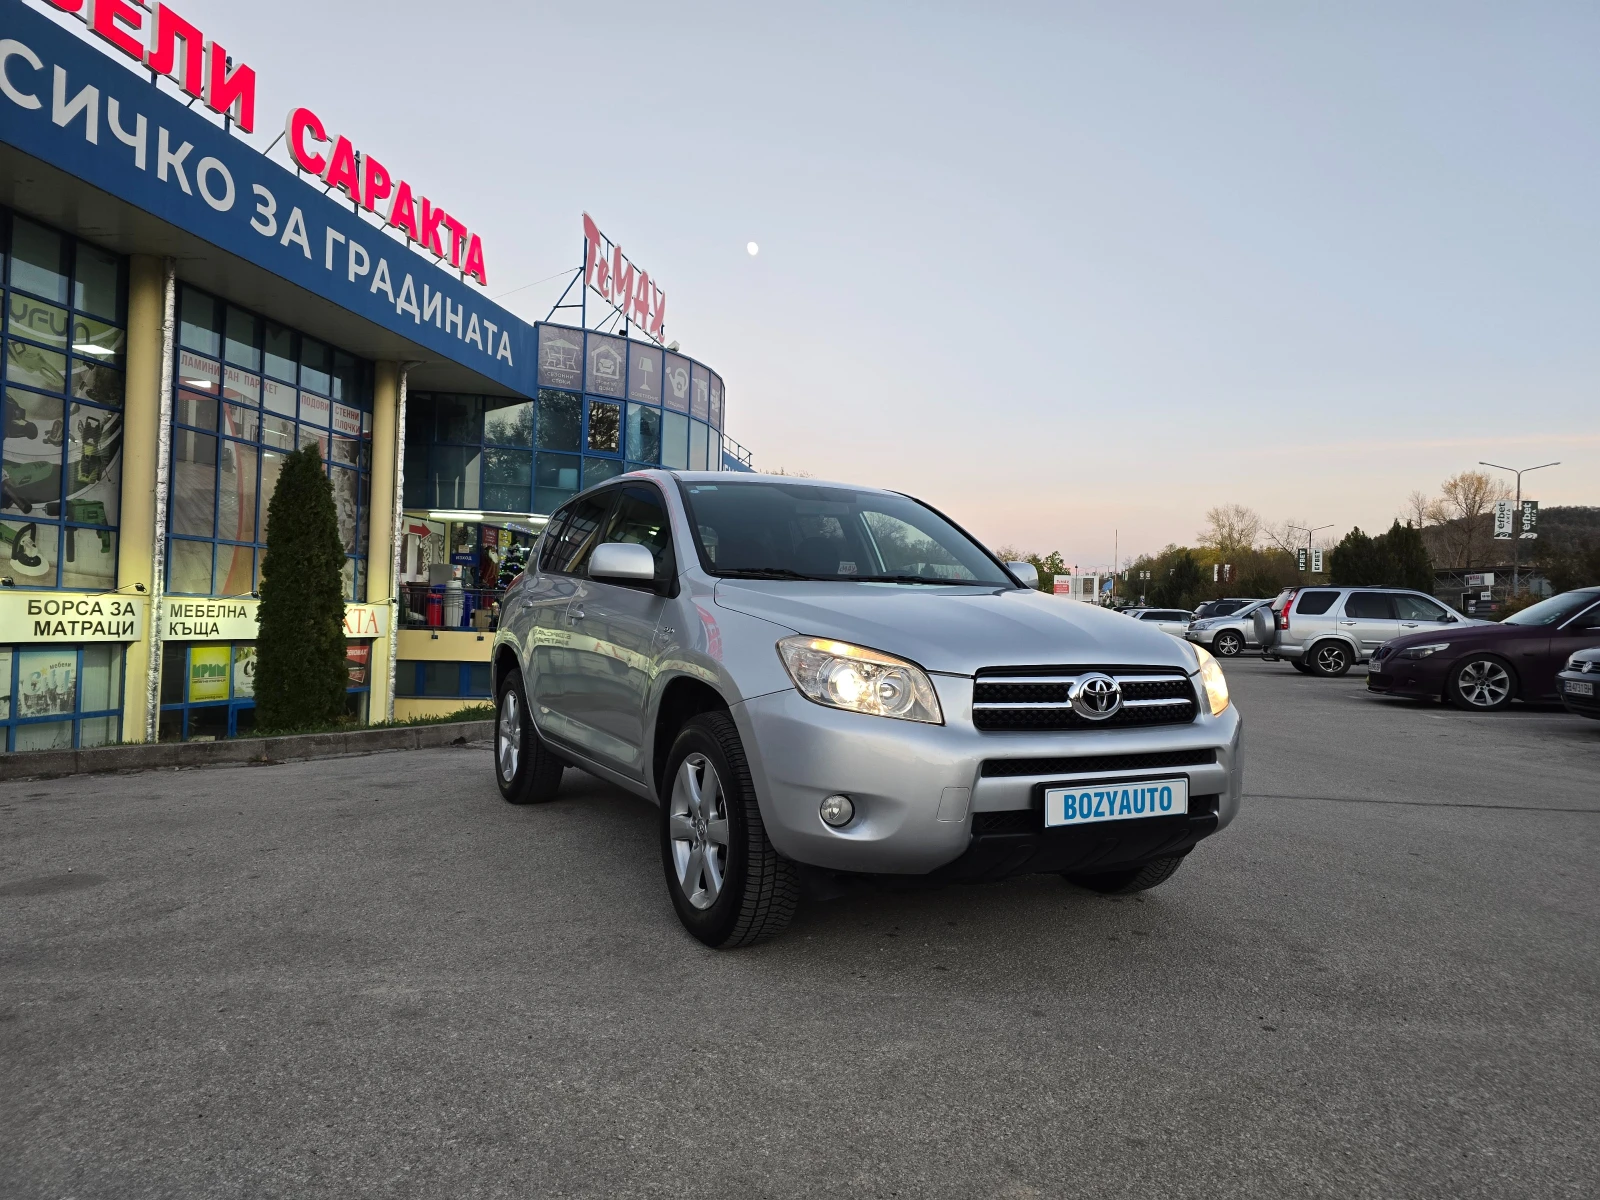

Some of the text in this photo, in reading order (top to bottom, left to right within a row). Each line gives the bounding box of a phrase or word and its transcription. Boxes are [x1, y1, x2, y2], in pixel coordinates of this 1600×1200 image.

[46, 0, 488, 286] ЕЛИ САРАКТА
[249, 183, 313, 260] ЗА
[324, 225, 514, 366] ГРАДИНАТА
[1497, 502, 1506, 530] efbet
[1523, 501, 1532, 531] efbet
[27, 599, 136, 617] БОРСА ЗА
[169, 603, 248, 619] МЕБЕЛНА
[33, 620, 135, 638] МАТРАЦИ
[168, 621, 220, 637] КЪЩА
[1063, 787, 1172, 819] BOZYAUTO
